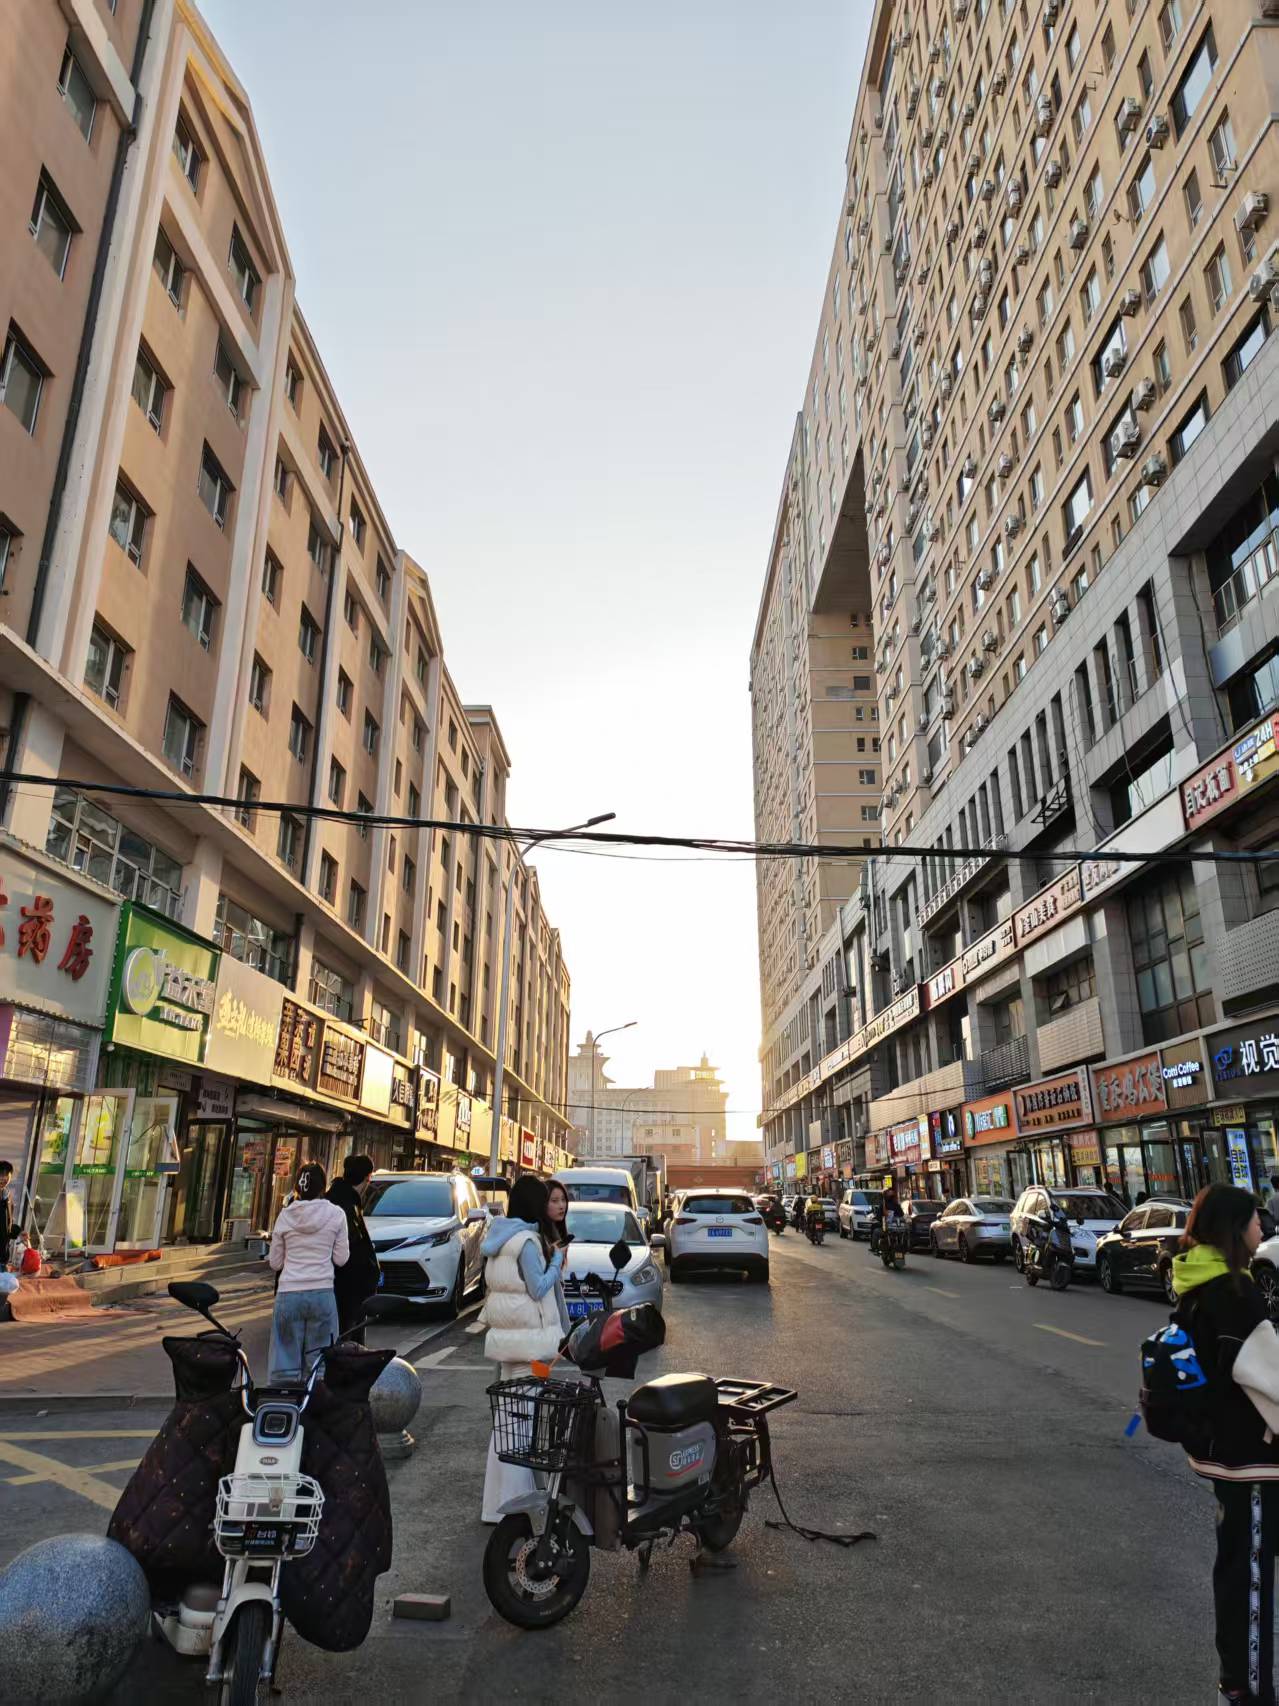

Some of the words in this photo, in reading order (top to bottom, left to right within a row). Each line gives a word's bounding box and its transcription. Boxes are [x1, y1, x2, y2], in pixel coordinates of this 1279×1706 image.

[0, 874, 93, 981] 药房
[1163, 1065, 1178, 1079] Cotti
[1178, 1061, 1200, 1075] Coffee
[1240, 1033, 1279, 1077] 视觉
